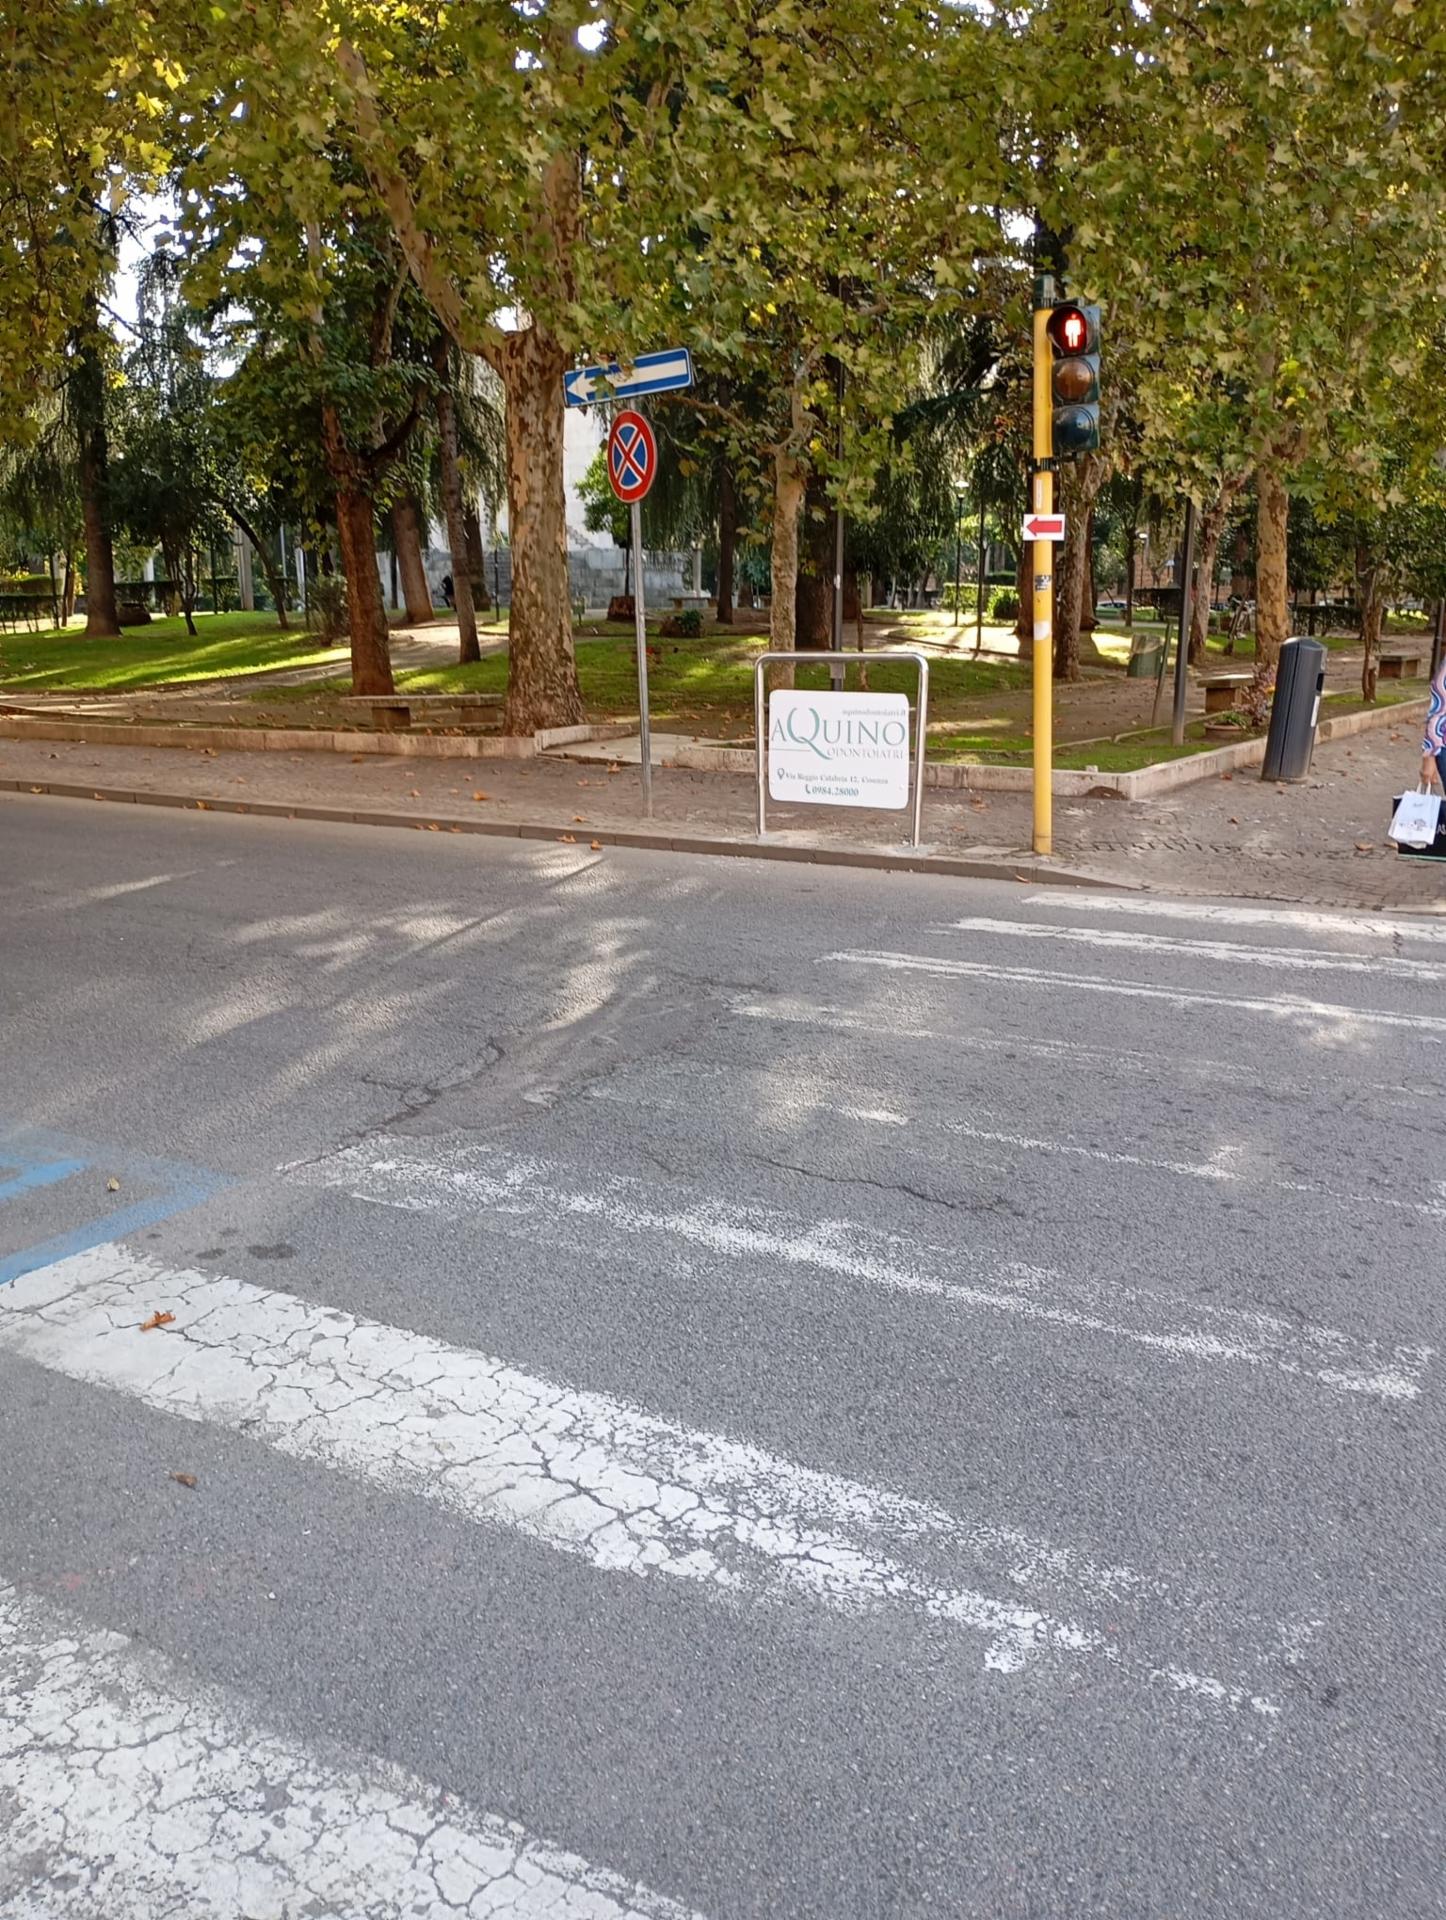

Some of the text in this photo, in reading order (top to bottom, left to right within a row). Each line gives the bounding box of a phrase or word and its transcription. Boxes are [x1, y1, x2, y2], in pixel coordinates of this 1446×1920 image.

[771, 707, 906, 759] AQUINO
[827, 748, 903, 760] ODONTOIATRI
[798, 773, 819, 783] Reggio
[821, 775, 848, 783] Calabria
[861, 776, 888, 785] Cosenza
